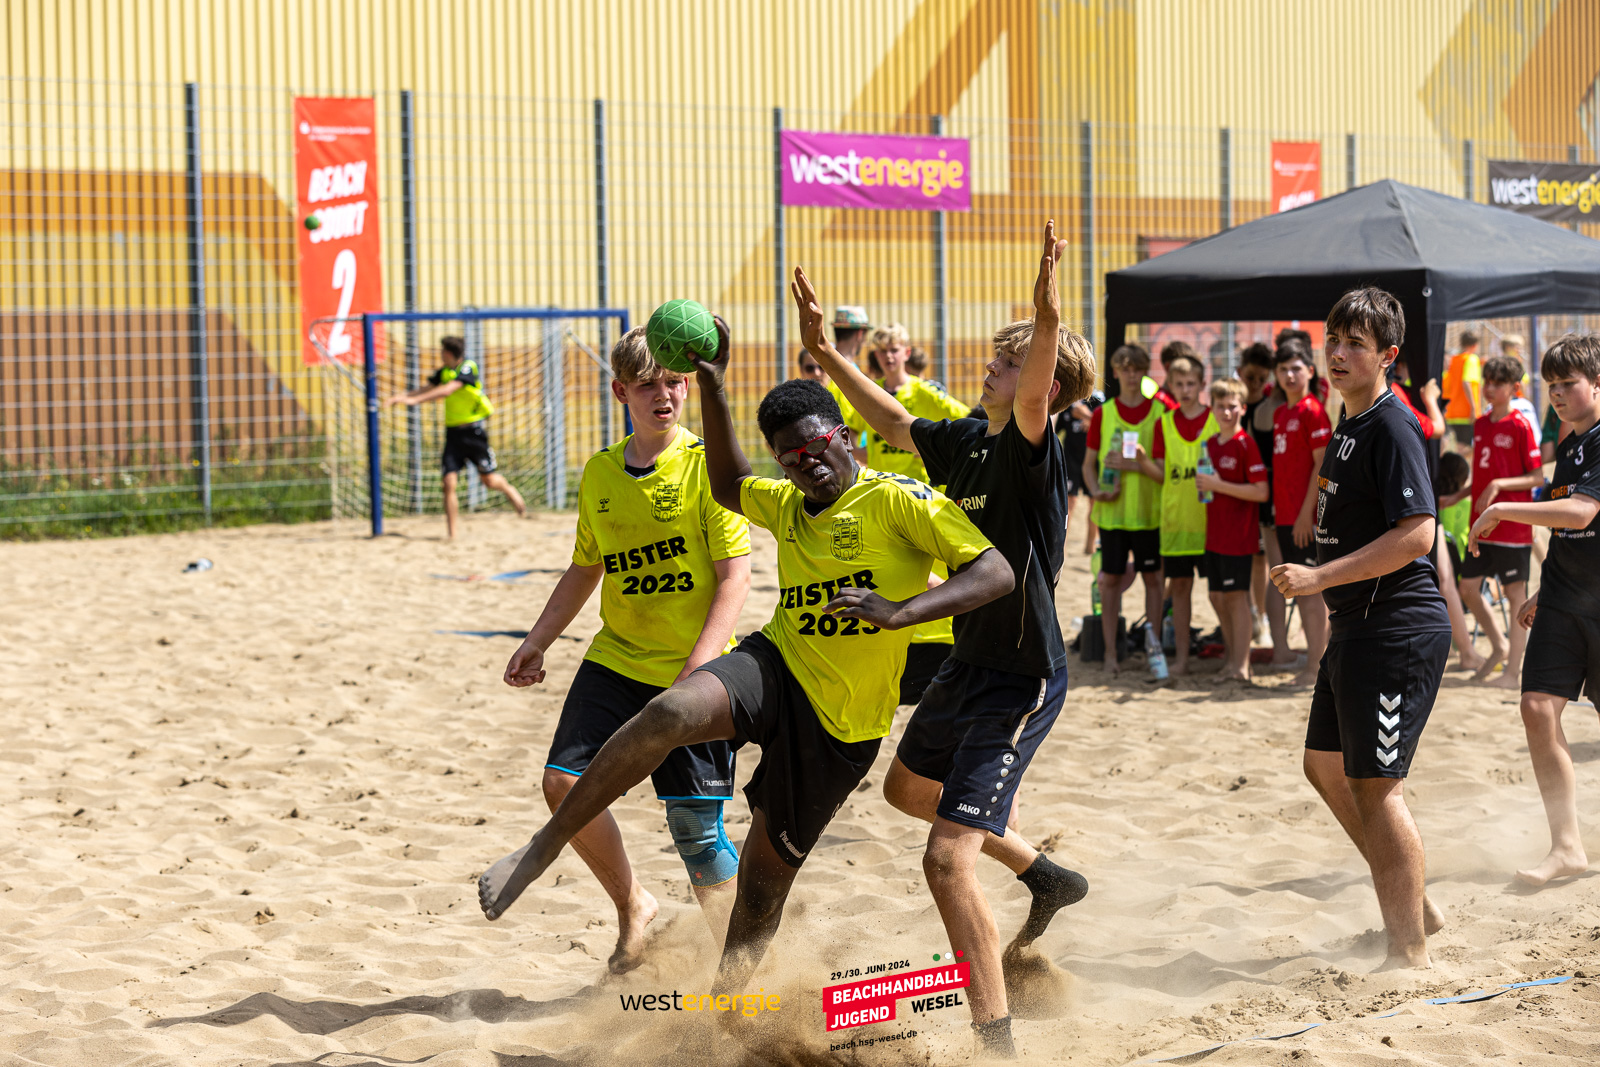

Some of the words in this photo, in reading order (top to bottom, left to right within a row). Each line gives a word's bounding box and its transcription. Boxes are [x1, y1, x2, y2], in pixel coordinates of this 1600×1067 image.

[308, 160, 367, 203] BEACH
[789, 149, 963, 197] westenergie
[309, 201, 369, 243] COURT
[328, 249, 357, 356] 2
[981, 449, 988, 463] 7
[1336, 435, 1356, 461] 10
[1479, 447, 1490, 468] 2
[1575, 446, 1584, 465] 3
[603, 535, 688, 575] EISTER
[622, 571, 695, 595] 2023
[956, 803, 981, 816] JAKO
